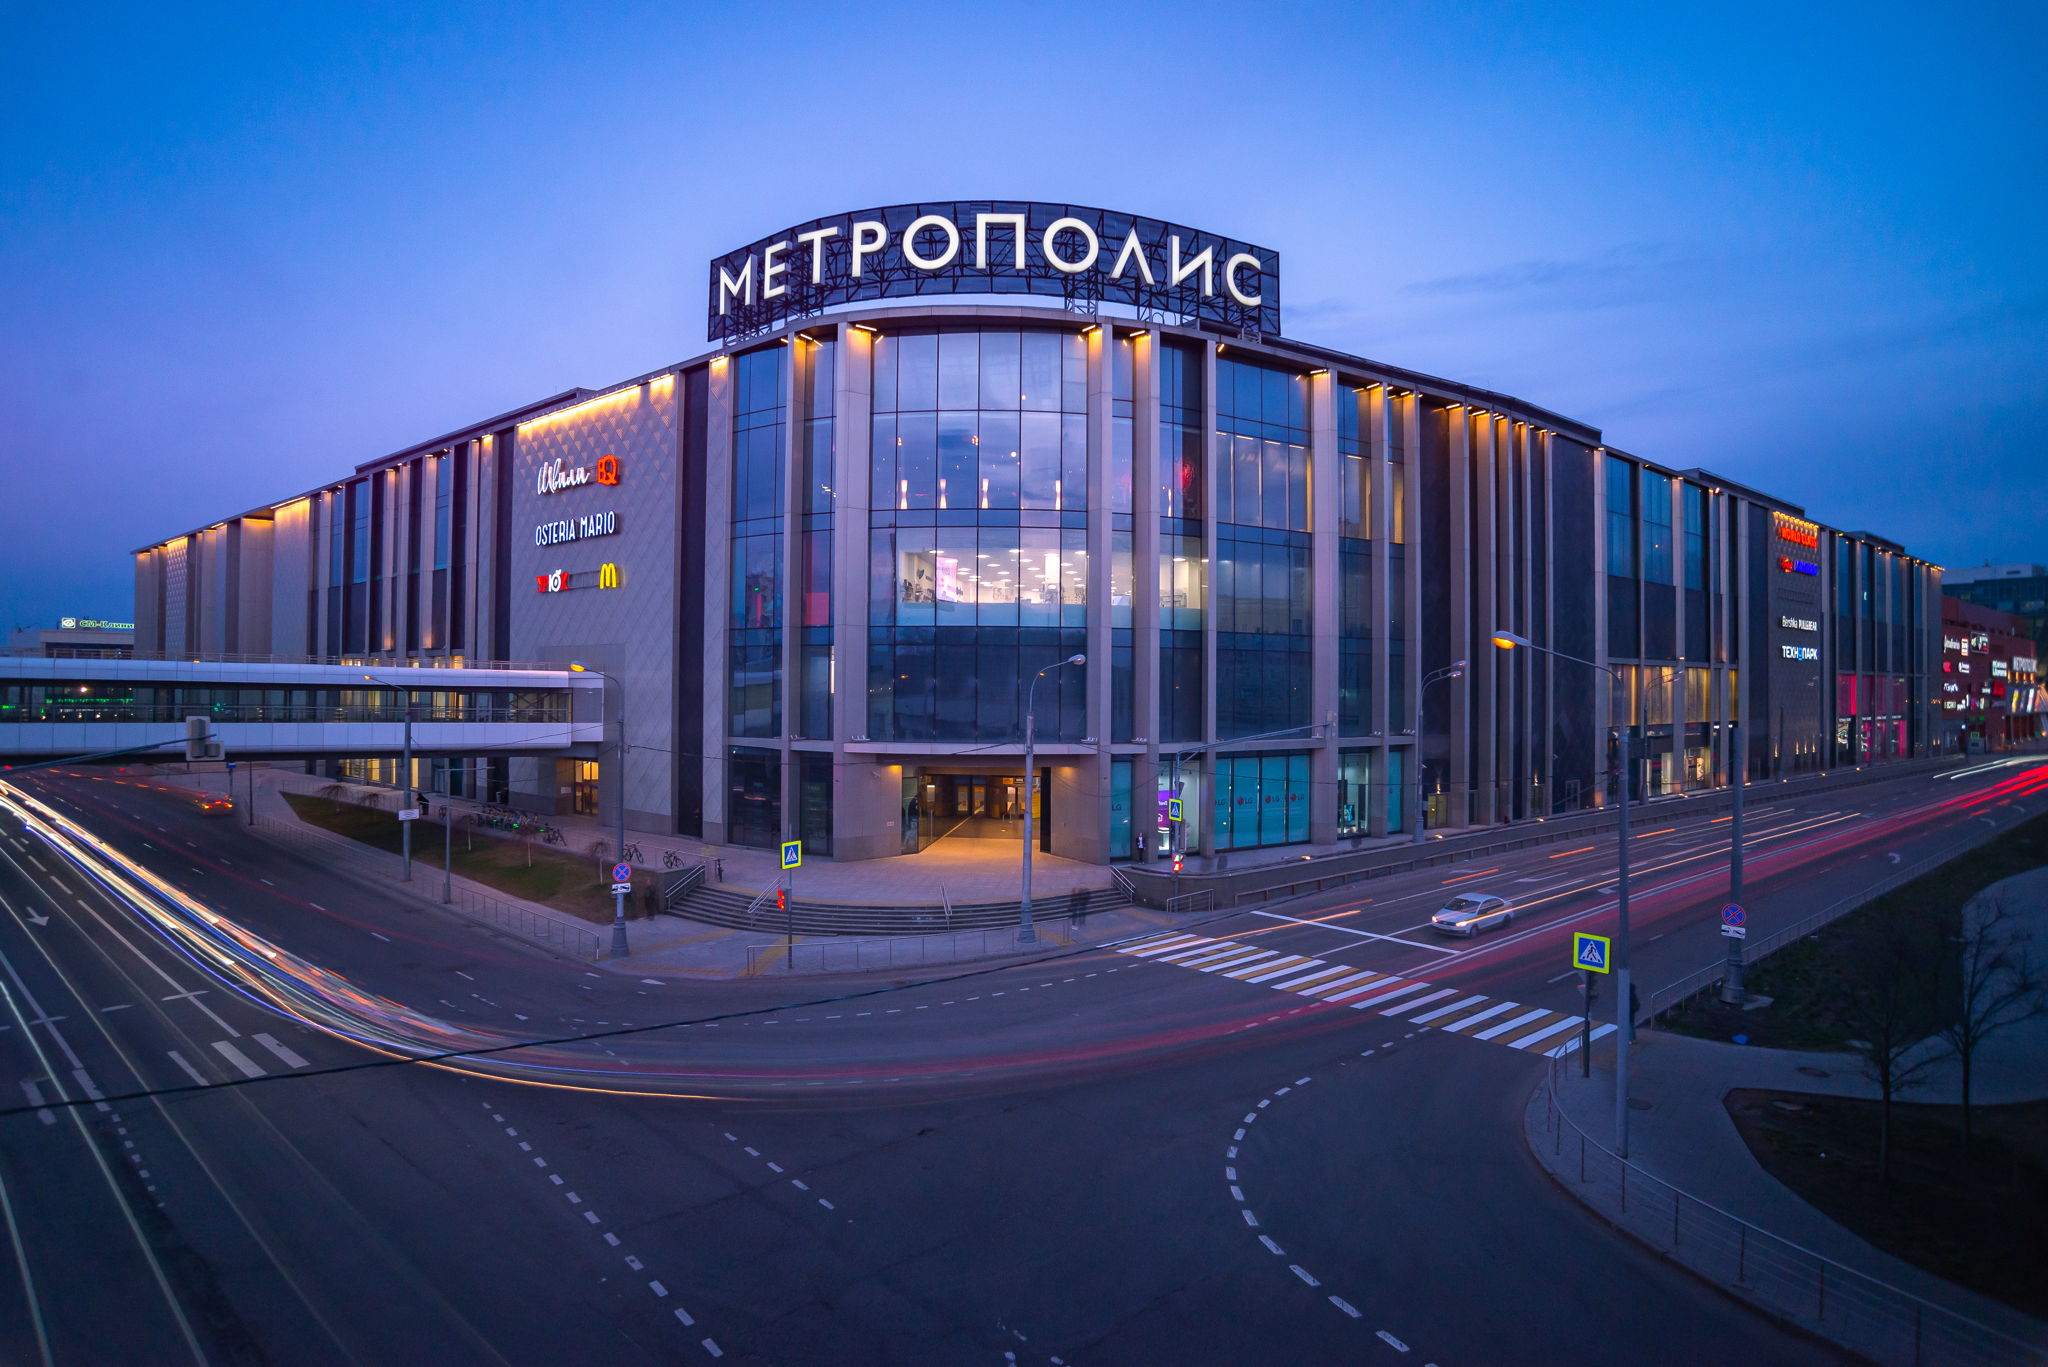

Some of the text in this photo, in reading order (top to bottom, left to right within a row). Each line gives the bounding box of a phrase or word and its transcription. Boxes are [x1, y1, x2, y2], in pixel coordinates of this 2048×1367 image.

[718, 212, 1263, 316] МЕТРОПОЛИС
[535, 511, 616, 546] OSTERIA MARIO
[1781, 526, 1801, 544] WORLD
